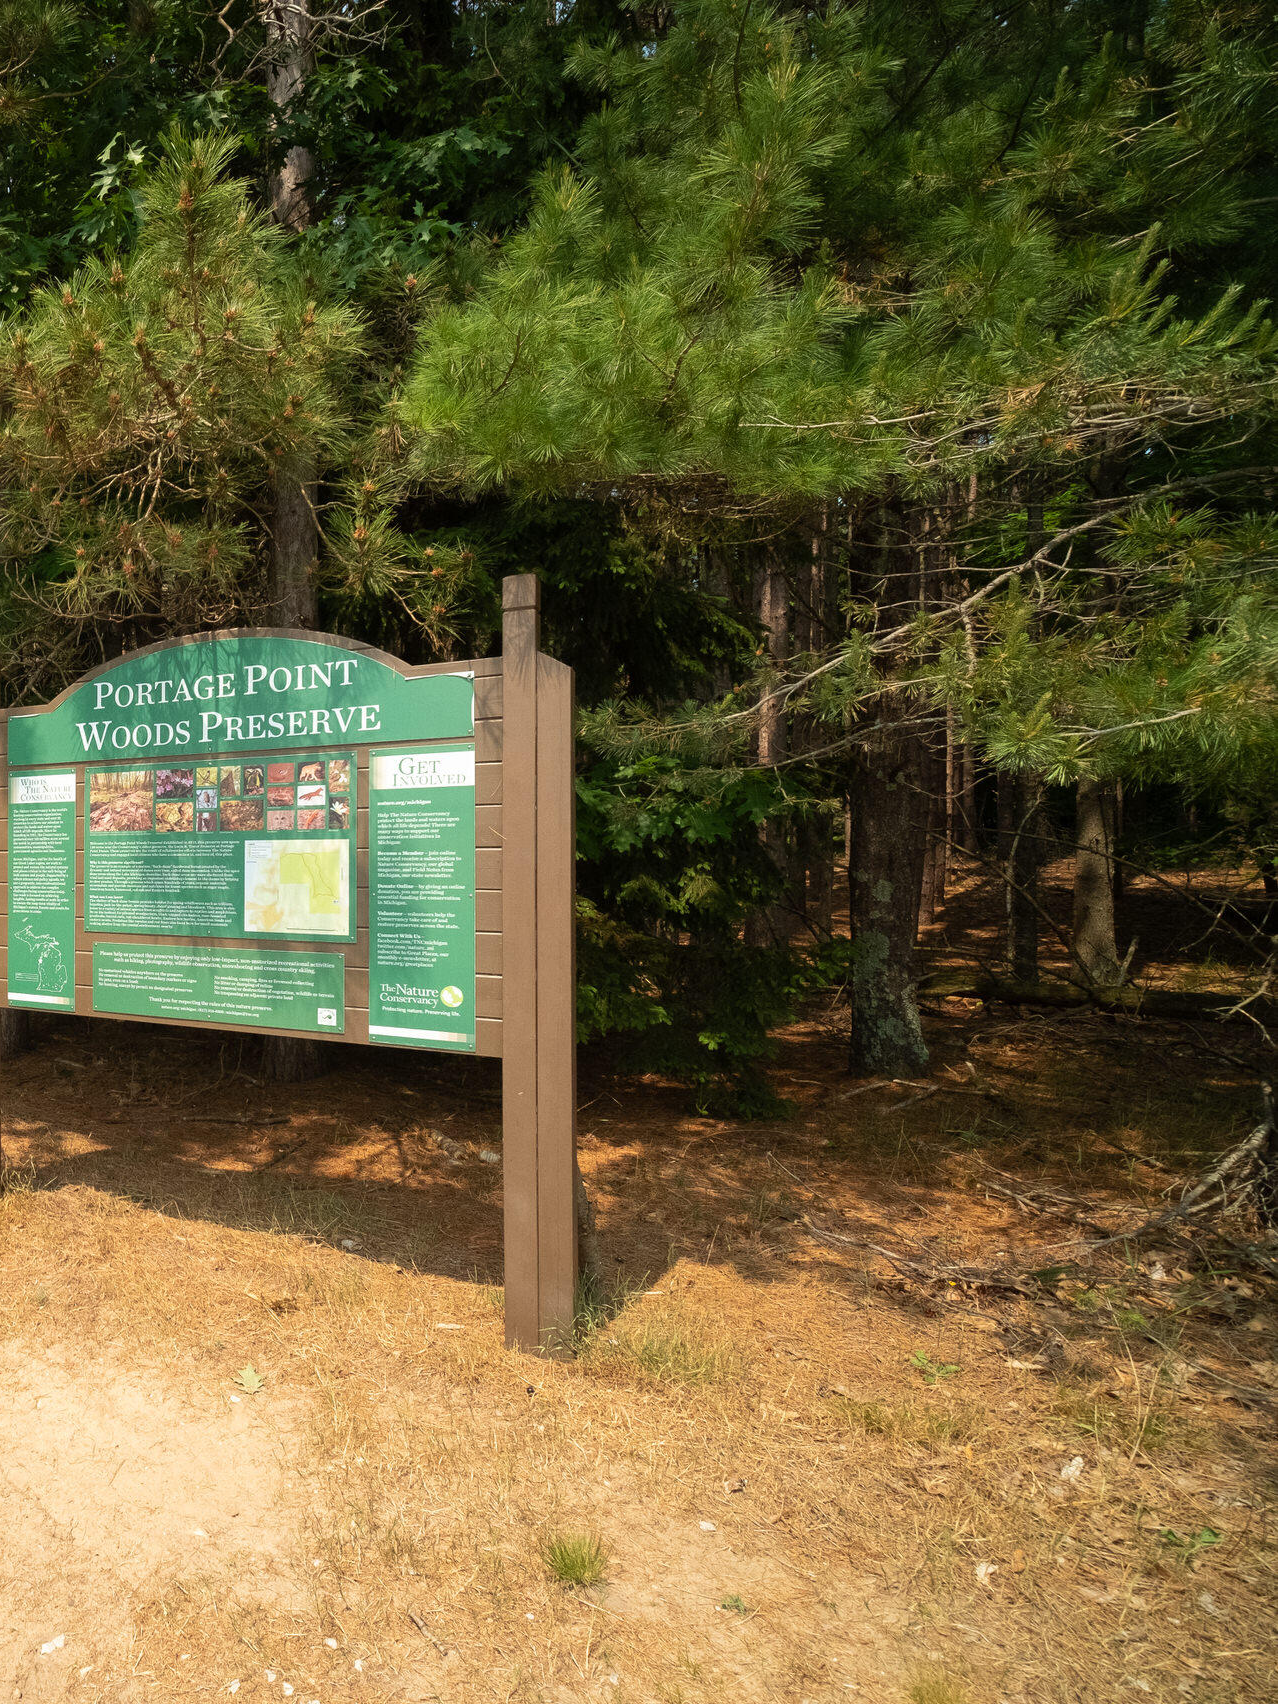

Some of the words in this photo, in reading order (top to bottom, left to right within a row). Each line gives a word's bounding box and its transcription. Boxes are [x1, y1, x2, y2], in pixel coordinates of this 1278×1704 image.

[93, 673, 236, 710] PORTAGE
[244, 659, 358, 696] POINT
[75, 719, 191, 751] WOODS
[198, 704, 381, 743] PRESERVE
[398, 757, 440, 775] GET
[393, 774, 466, 786] INVOLVED
[380, 984, 395, 992] The
[396, 984, 439, 997] Nature
[379, 992, 438, 1008] Conservancy
